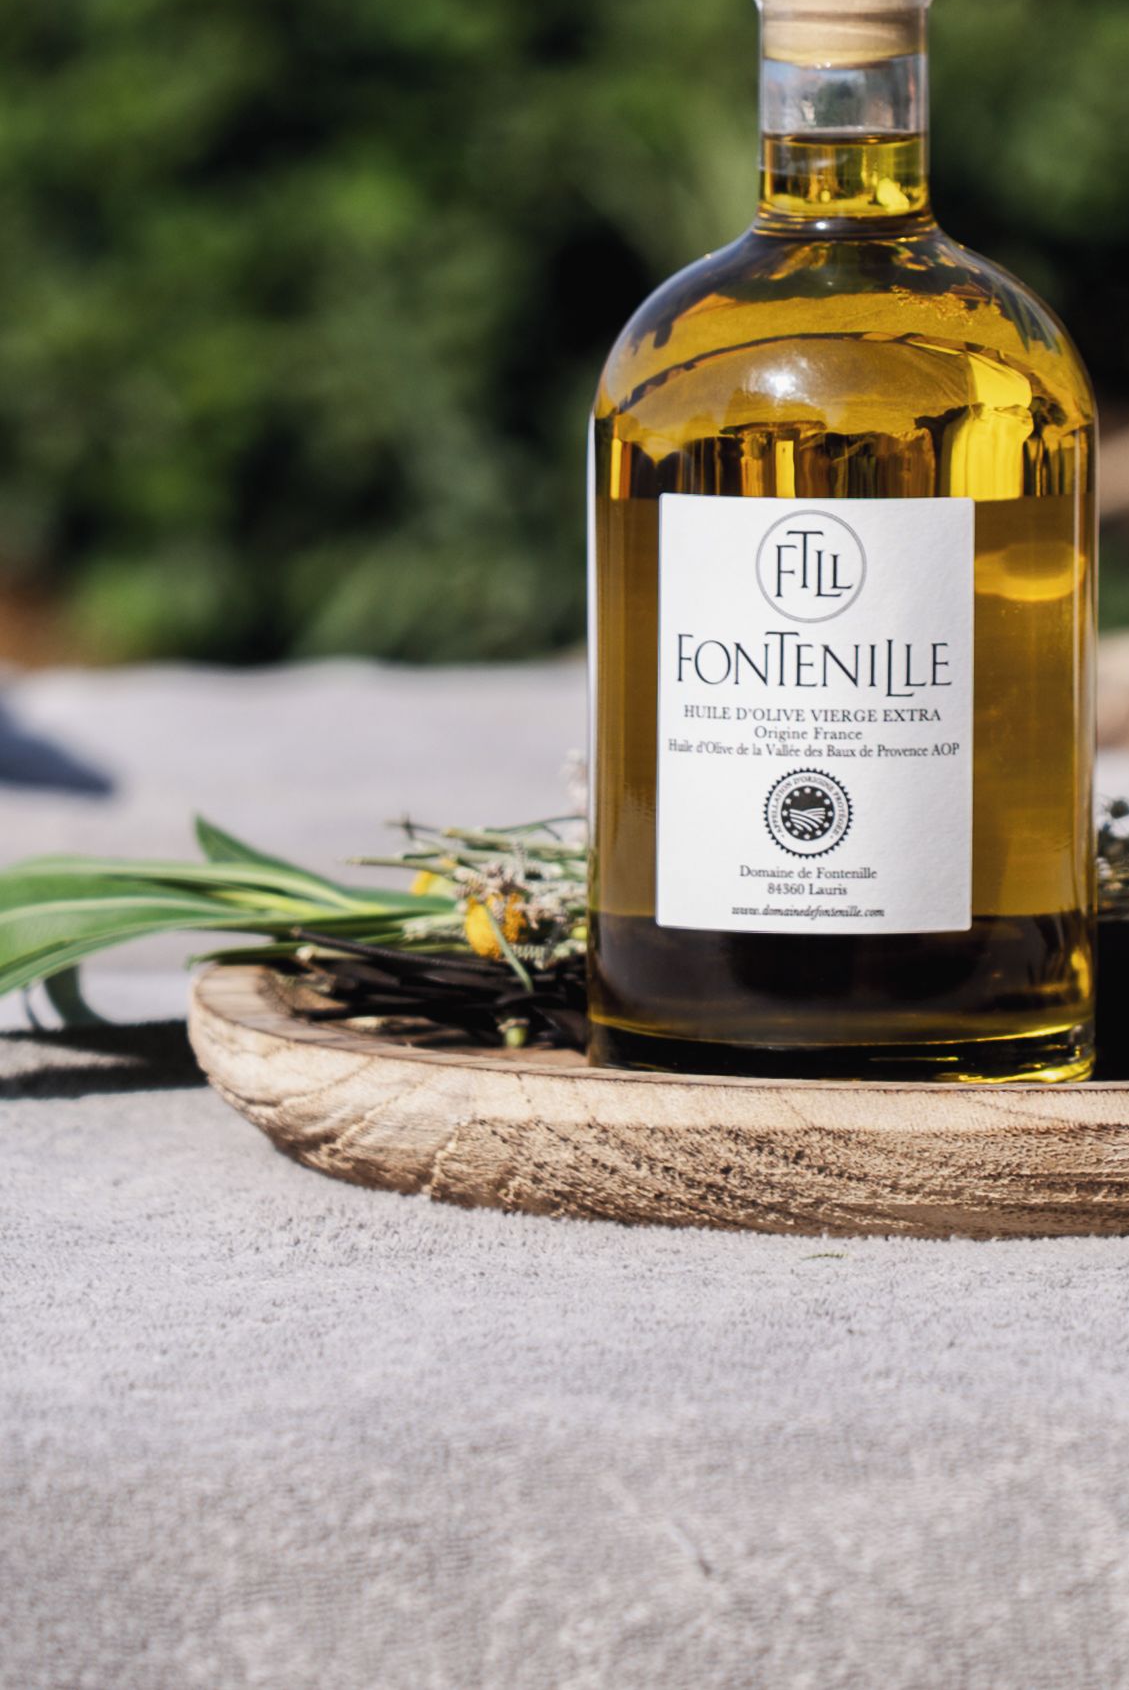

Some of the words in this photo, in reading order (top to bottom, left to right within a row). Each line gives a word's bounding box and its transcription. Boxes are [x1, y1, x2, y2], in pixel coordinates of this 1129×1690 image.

[677, 631, 953, 698] FONTENILLE
[683, 704, 731, 720] HUILE
[735, 707, 806, 722] D'OLIVE
[811, 708, 878, 722] VIERGE
[883, 708, 942, 722] EXTRA
[754, 725, 809, 742] Origine
[813, 727, 863, 740] France
[668, 738, 694, 753] Huile
[696, 740, 733, 755] d'Olive
[736, 742, 749, 756] de
[752, 743, 762, 756] la
[766, 743, 801, 757] Vallée
[804, 744, 823, 757] des
[826, 744, 856, 758] Baux
[859, 744, 874, 757] de
[877, 744, 929, 757] Provence
[931, 742, 960, 756] AOP
[739, 864, 795, 878] Domaine
[797, 866, 813, 879] de
[816, 867, 878, 879] Fontenille
[767, 882, 805, 895] 84360
[808, 883, 848, 896] Lauris
[731, 904, 885, 920] www.domainedefontenille.com
